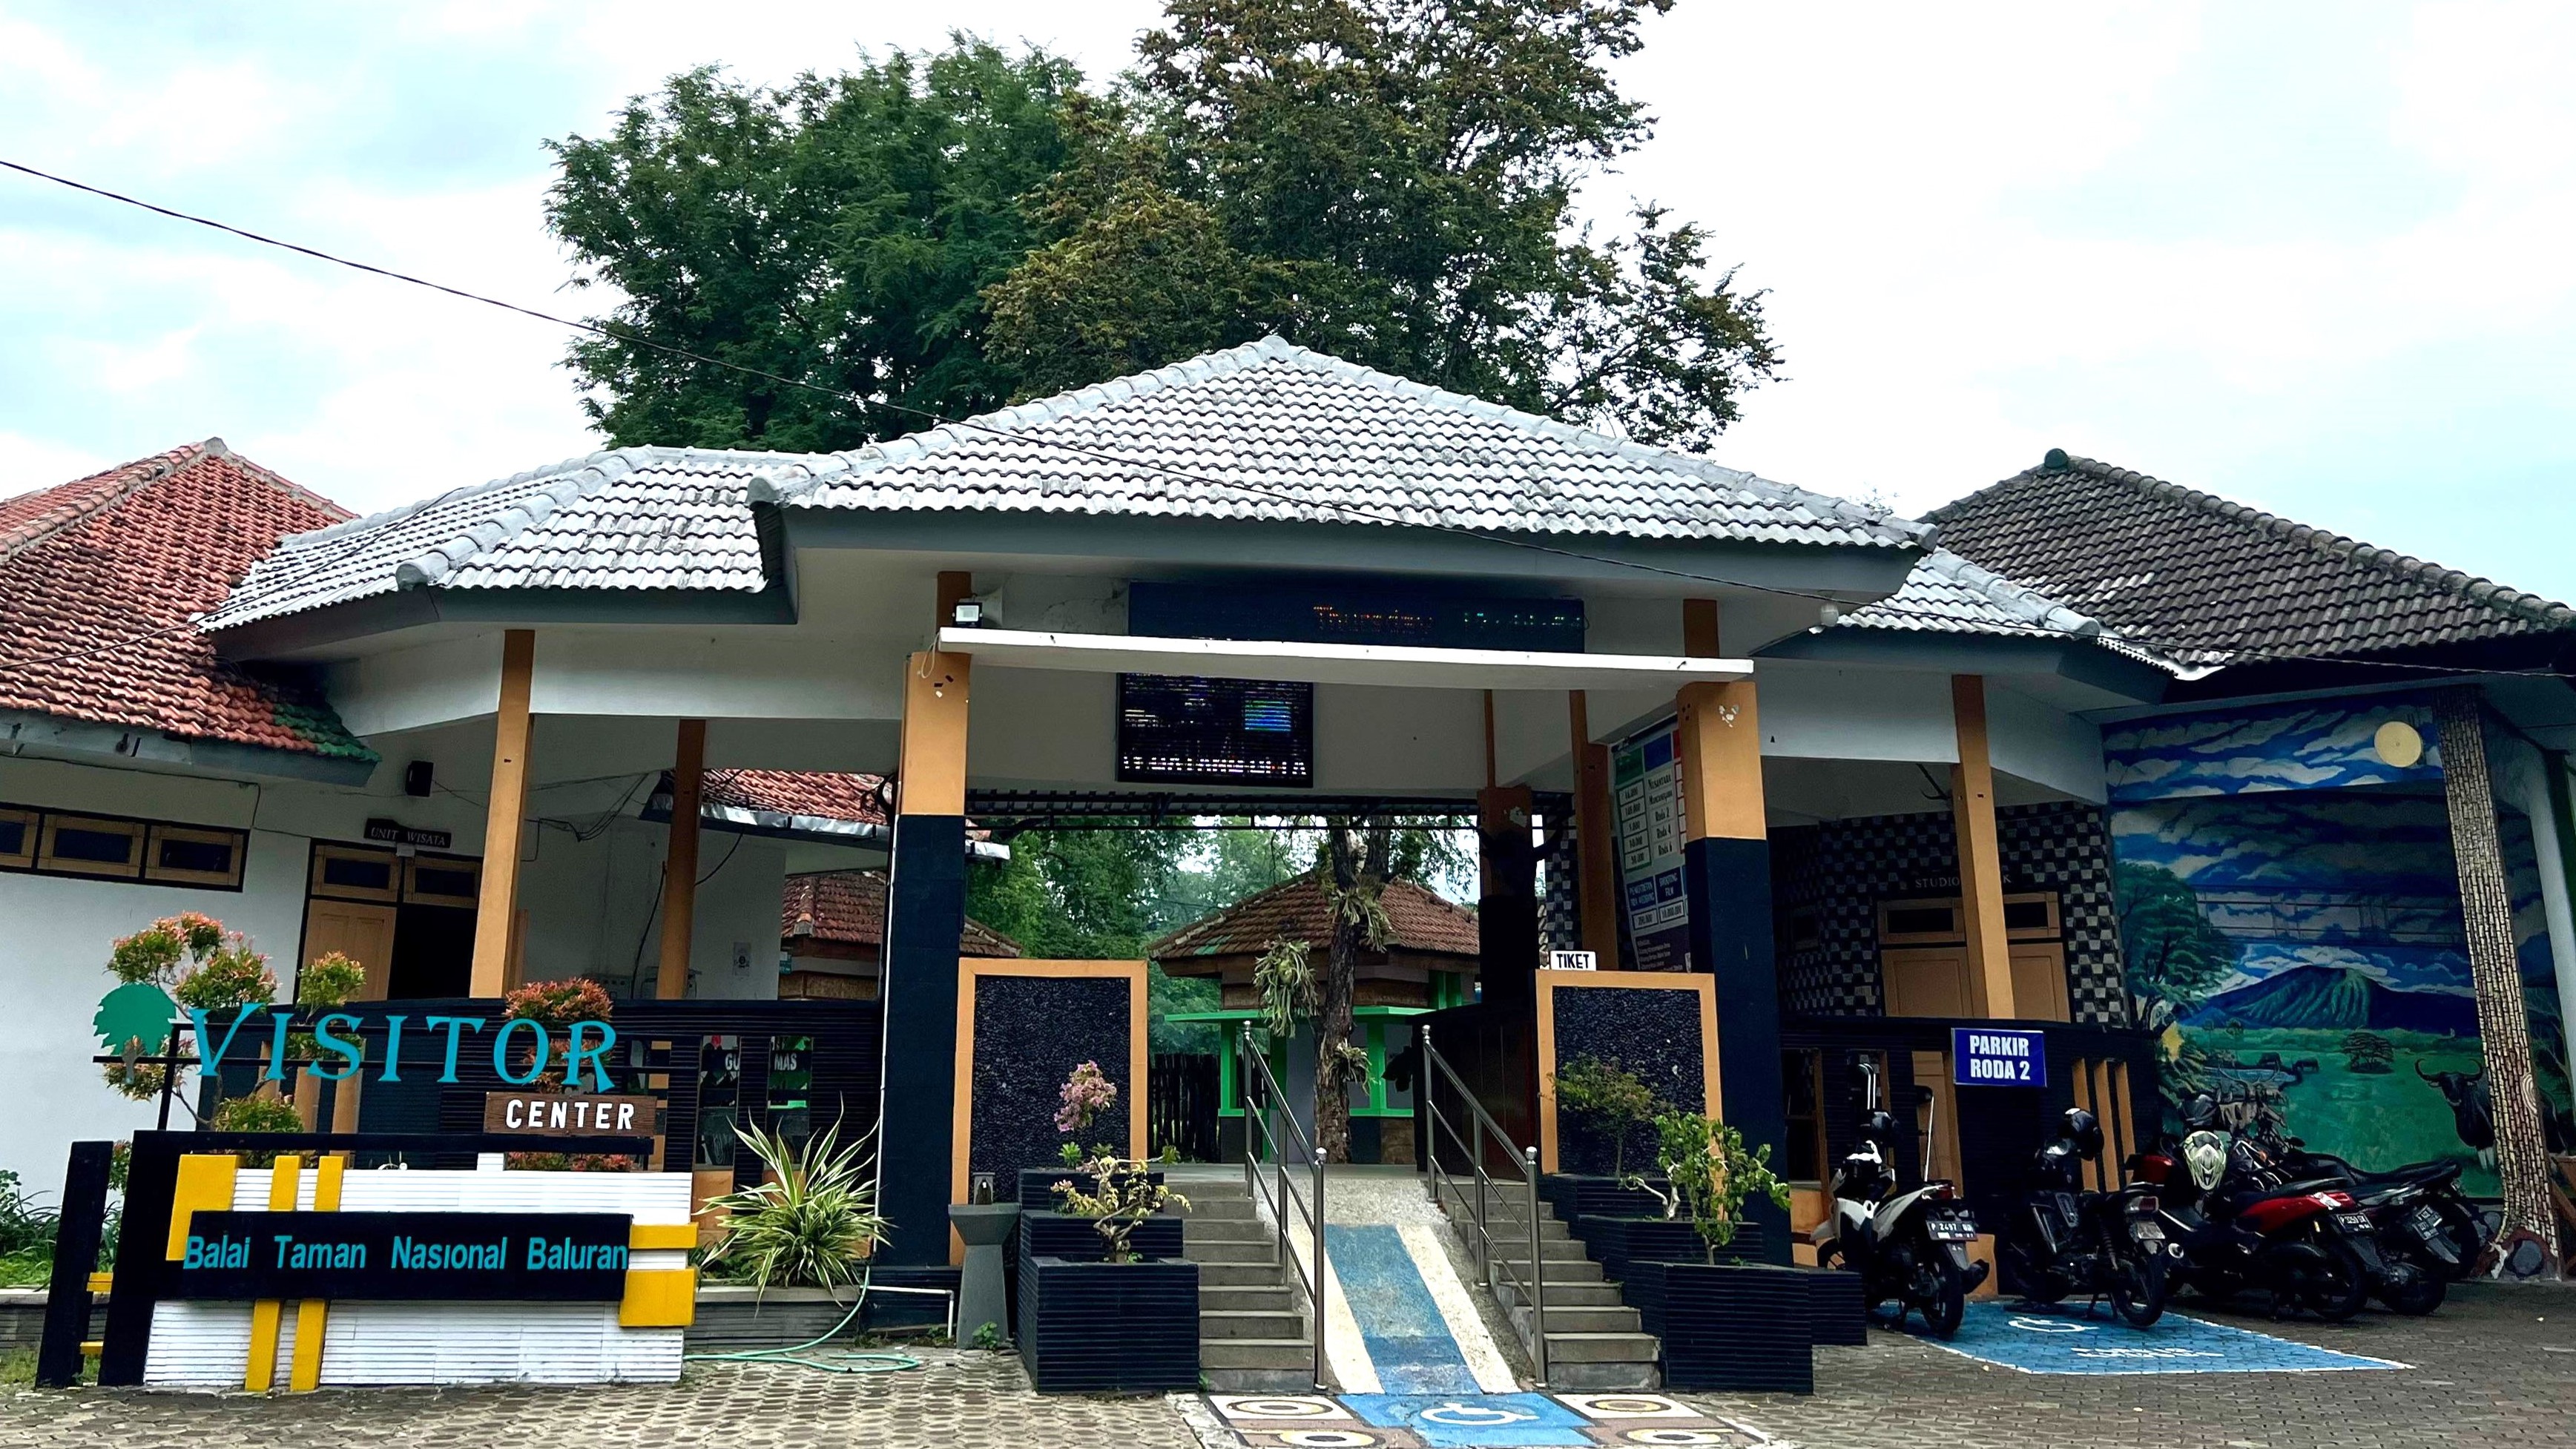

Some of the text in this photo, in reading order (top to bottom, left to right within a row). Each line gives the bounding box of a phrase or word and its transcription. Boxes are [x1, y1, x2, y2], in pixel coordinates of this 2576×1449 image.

[371, 827, 446, 845] UNIT WISATA
[1915, 876, 1960, 888] STUDIO
[1556, 953, 1590, 969] TIKET
[187, 1001, 616, 1094] VISITOR
[1969, 1034, 2029, 1057] PARKIR
[1970, 1058, 2031, 1080] RODA 2
[506, 1099, 635, 1130] CENTER
[183, 1234, 628, 1270] Balai Taman Nasional Baluran
